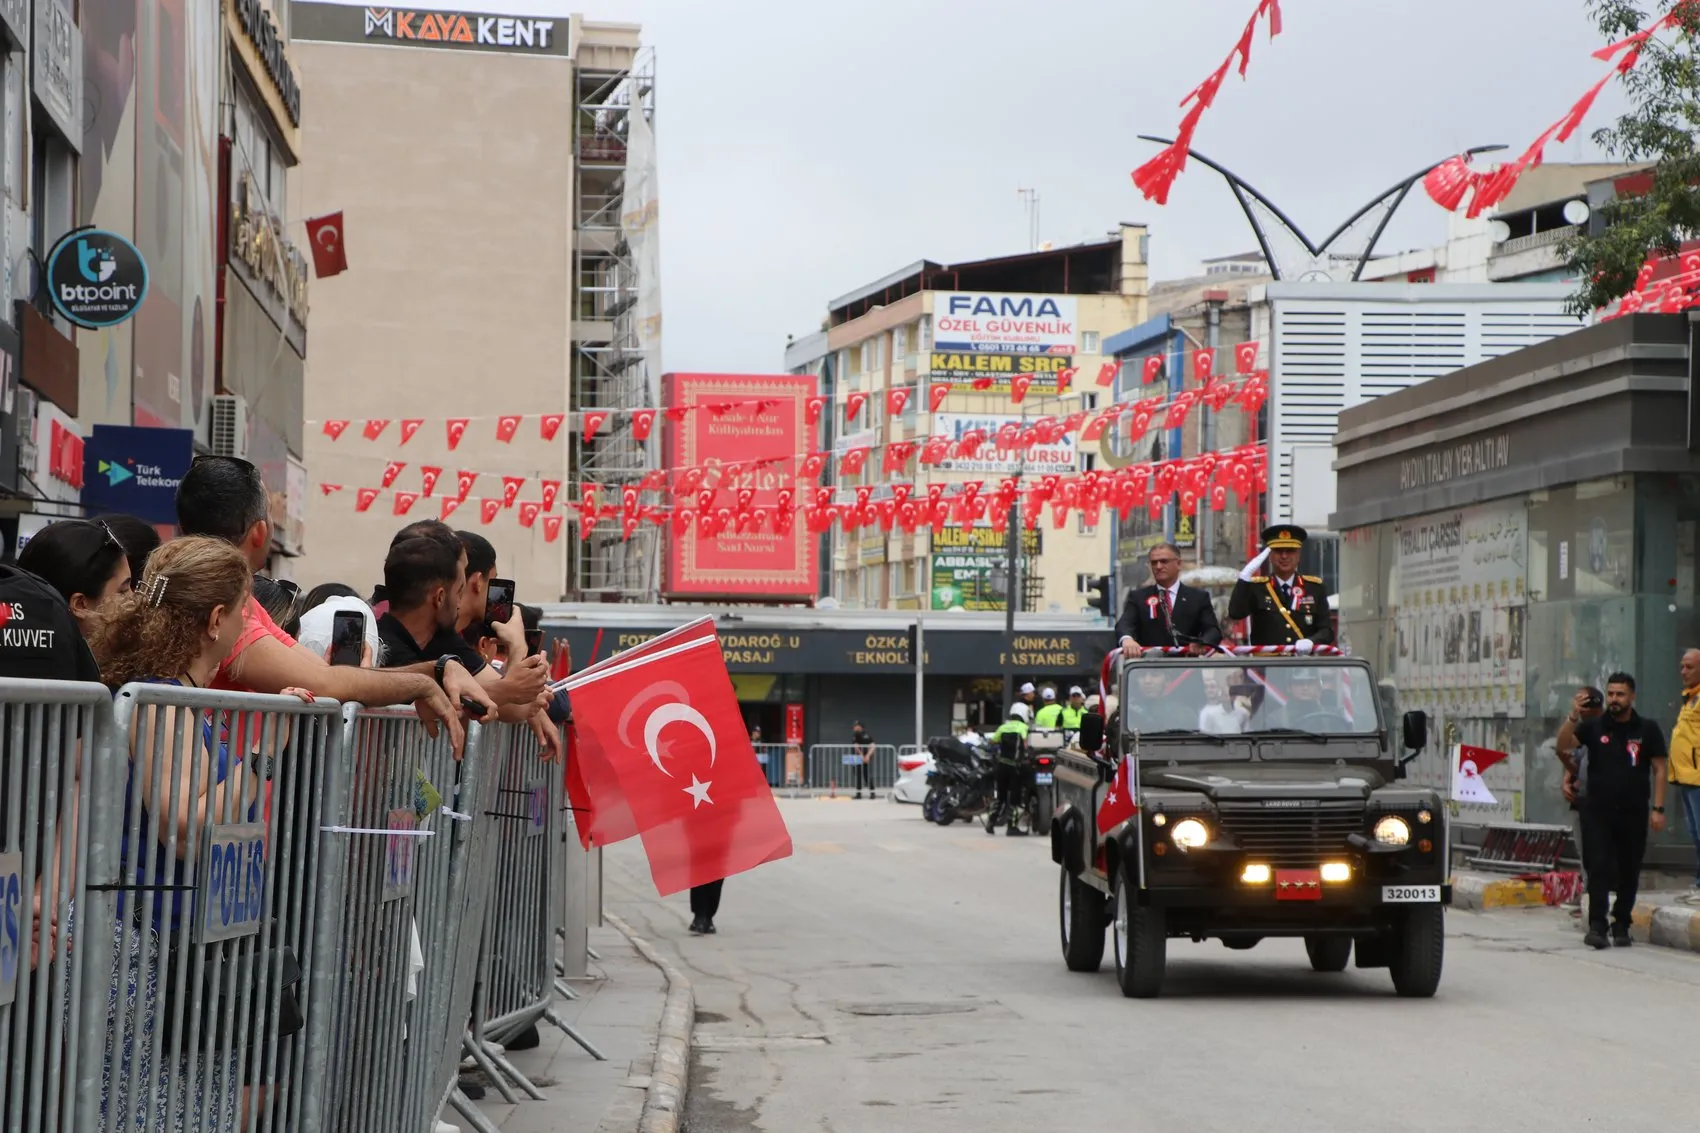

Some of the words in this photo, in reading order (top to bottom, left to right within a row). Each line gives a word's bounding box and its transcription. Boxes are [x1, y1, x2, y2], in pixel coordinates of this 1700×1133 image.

[397, 12, 474, 42] KAYA
[478, 17, 553, 47] KENT
[61, 282, 136, 304] btpoint
[950, 296, 1061, 318] FAMA
[938, 316, 981, 332] ÖZEL
[986, 318, 1072, 335] GÜVENLİK
[932, 353, 1011, 371] KALEM
[1019, 356, 1067, 373] SRC
[136, 464, 160, 475] Türk
[1400, 456, 1426, 489] AYDIN
[1426, 448, 1453, 483] TALAY
[3, 628, 55, 648] KUVVET
[1387, 889, 1436, 899] 320013
